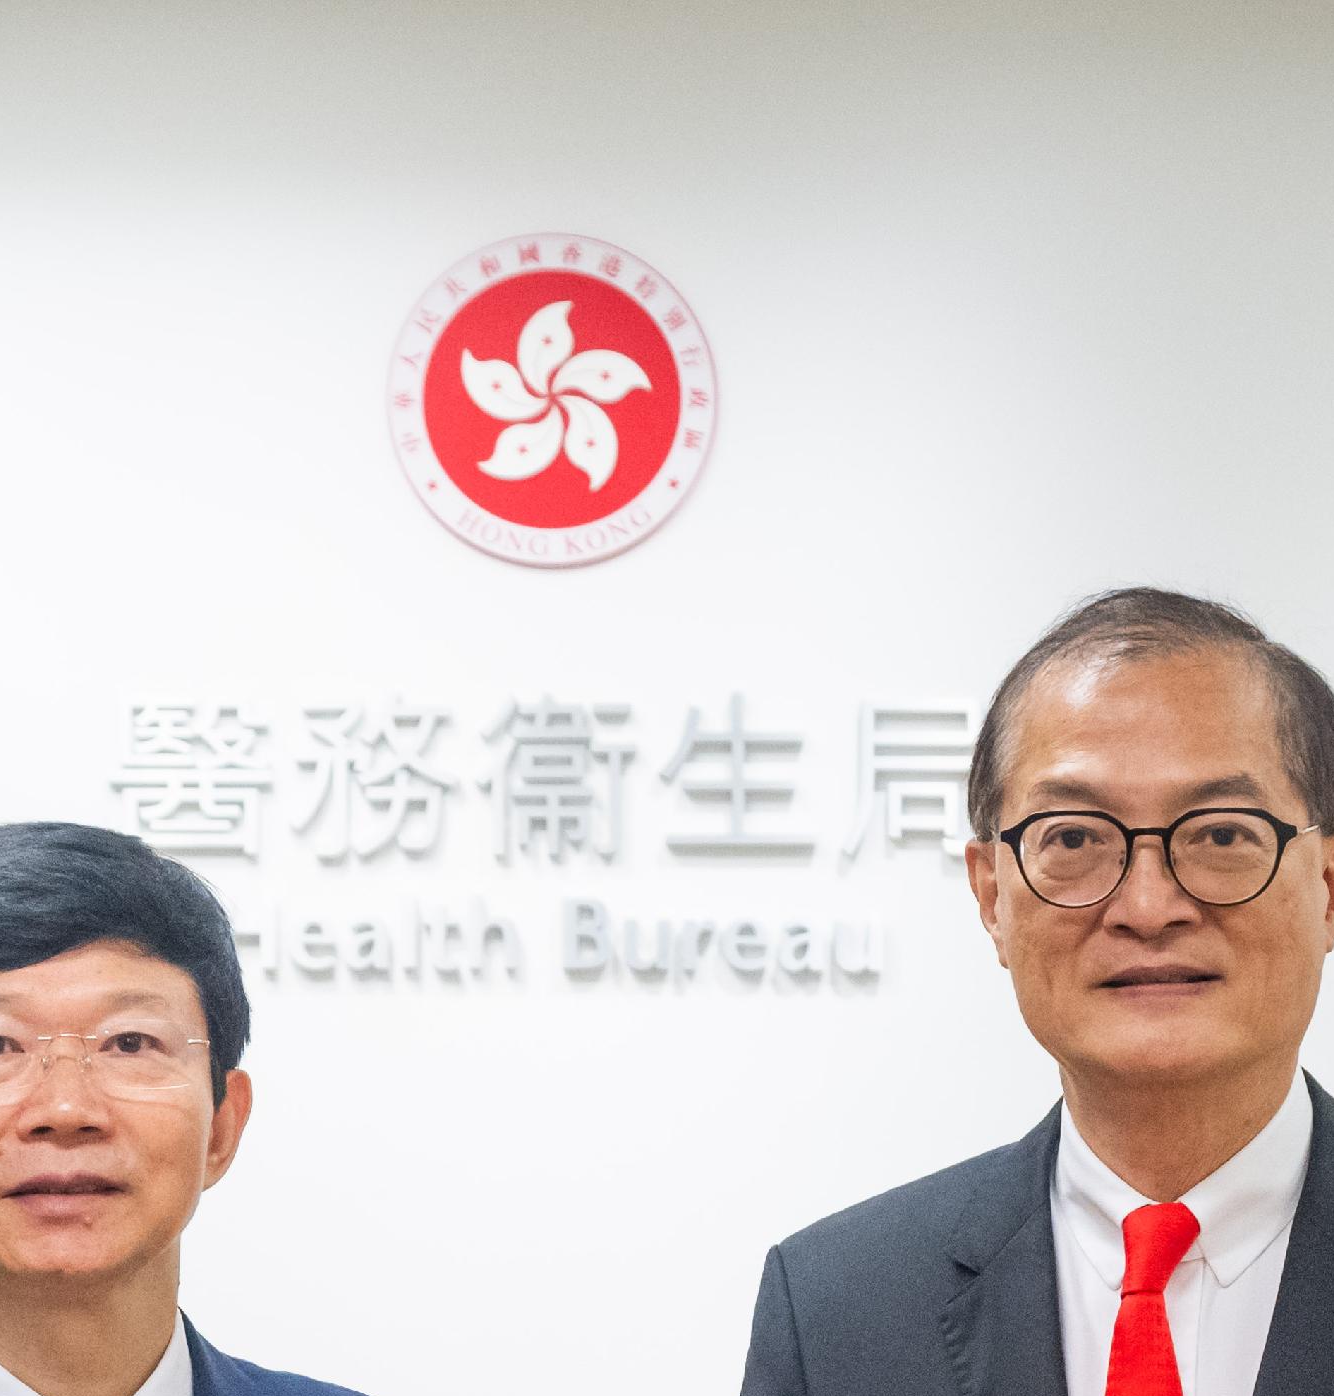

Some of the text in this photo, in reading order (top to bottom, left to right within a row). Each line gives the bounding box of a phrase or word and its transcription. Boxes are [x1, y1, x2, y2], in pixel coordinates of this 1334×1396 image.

[457, 504, 652, 556] HONG KONG
[561, 896, 885, 983] Bureau
